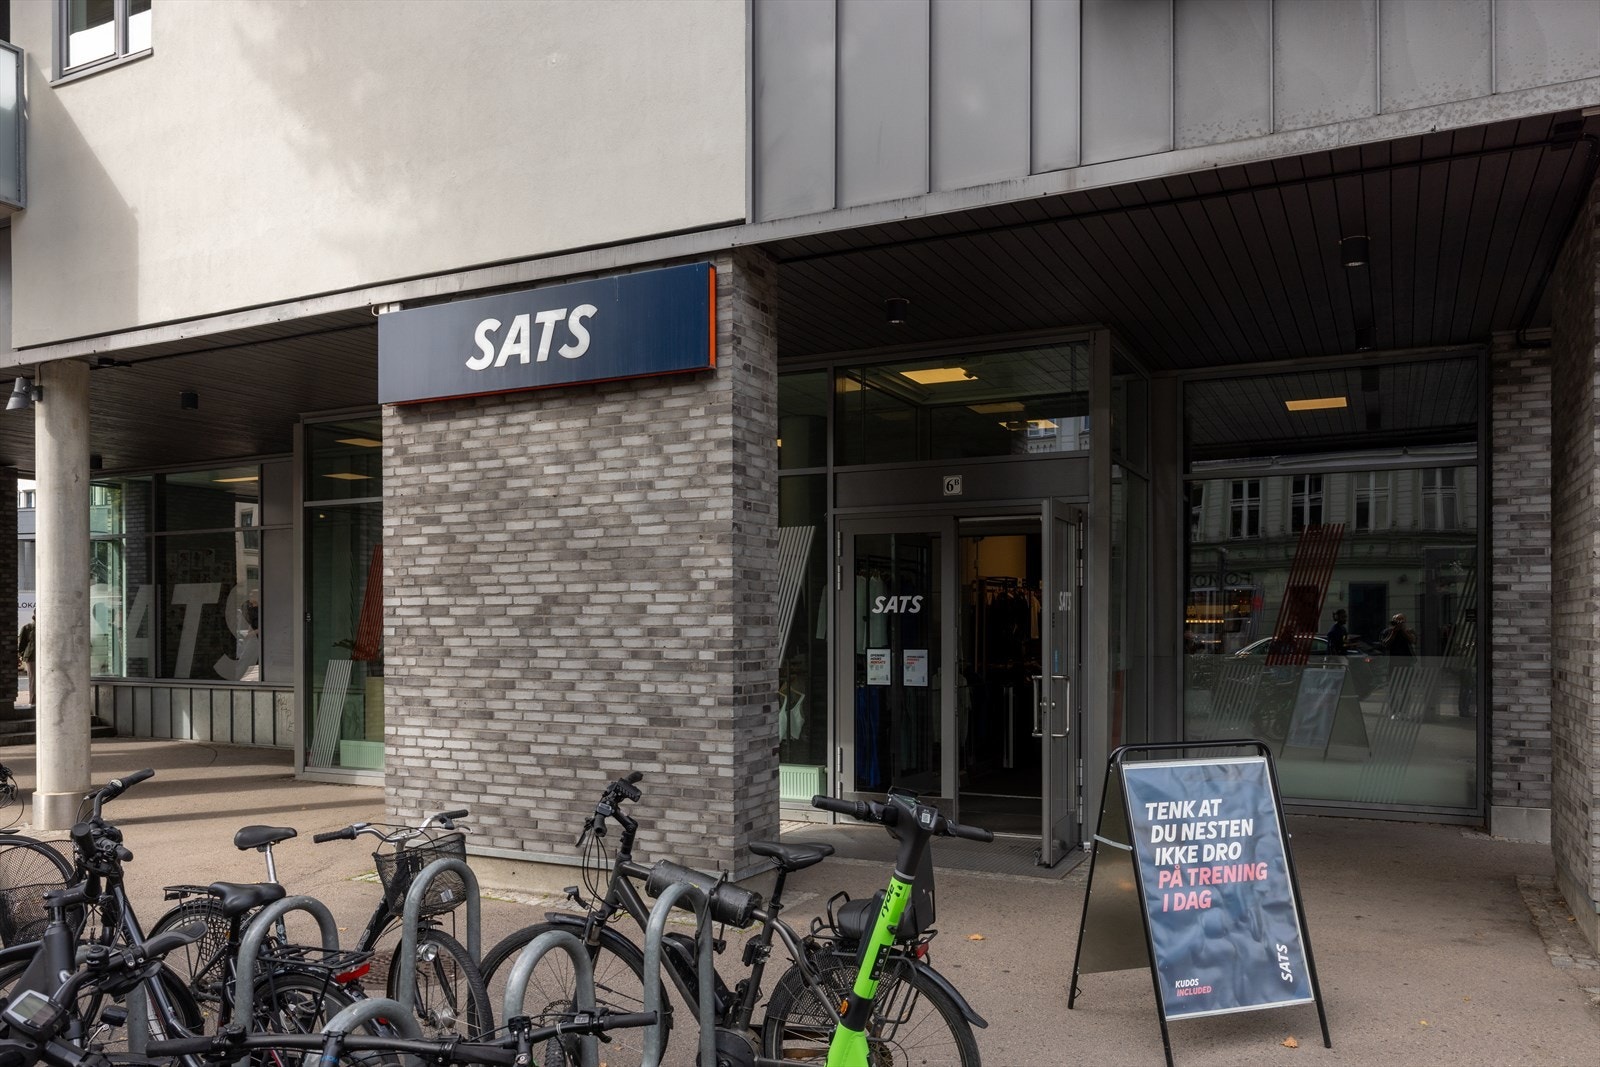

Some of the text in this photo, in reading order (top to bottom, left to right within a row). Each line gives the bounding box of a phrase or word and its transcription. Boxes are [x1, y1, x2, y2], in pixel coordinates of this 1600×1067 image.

[465, 303, 598, 371] SATS
[946, 479, 960, 492] 6B
[872, 595, 924, 614] SATS
[1058, 591, 1072, 611] SATS
[1145, 799, 1222, 820] TENK AT
[1151, 819, 1254, 843] DU NESTEN
[1155, 842, 1242, 866] IKKE DRO
[1159, 862, 1268, 889] PÅ TRENING
[881, 884, 894, 917] ryde
[1163, 889, 1212, 912] I DAG
[1276, 943, 1293, 983] SATS
[1175, 978, 1199, 989] KUDOS
[1177, 985, 1212, 997] INCLUDED
